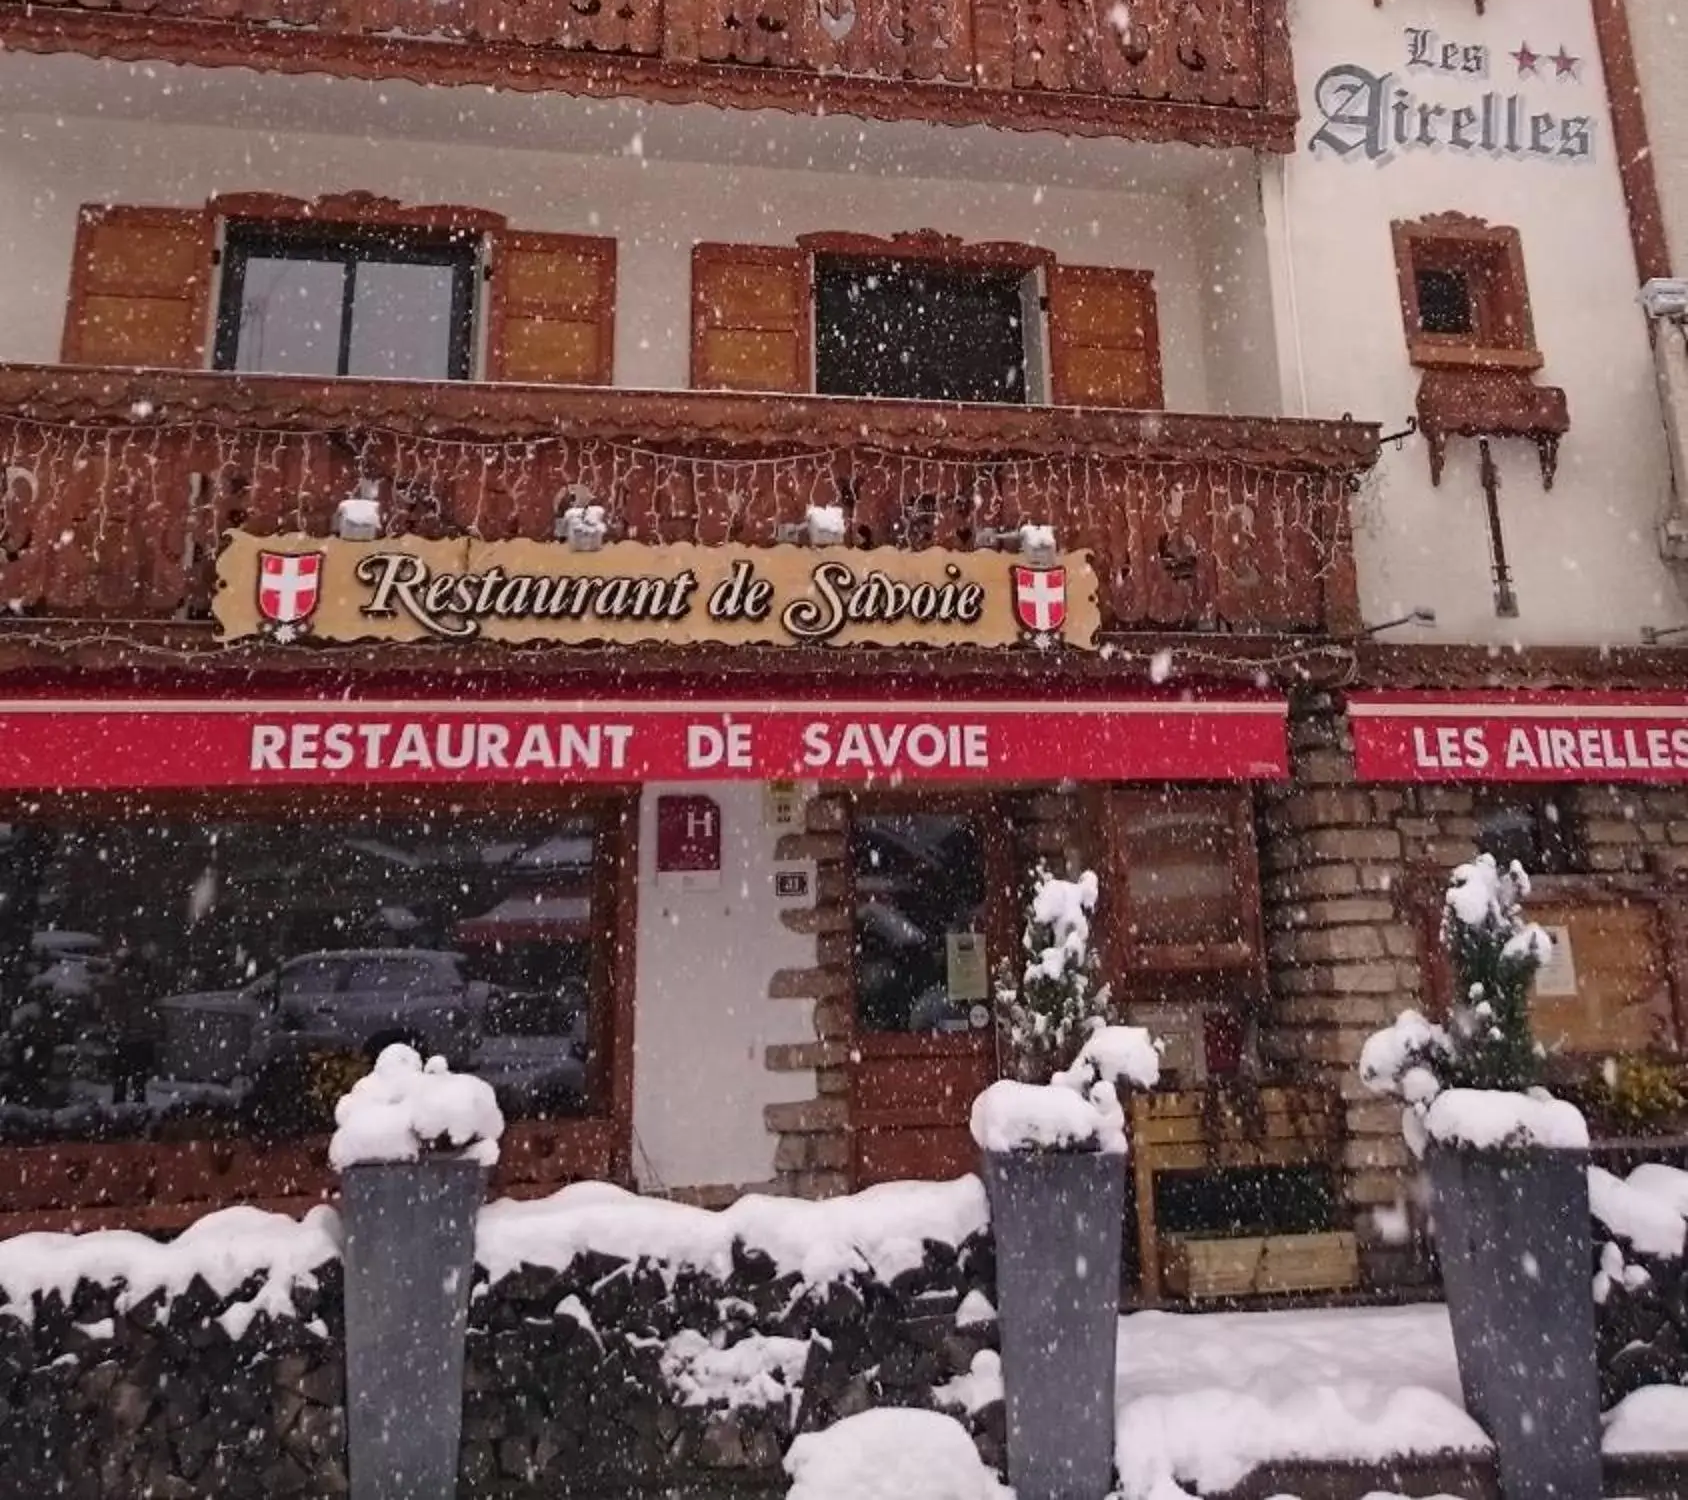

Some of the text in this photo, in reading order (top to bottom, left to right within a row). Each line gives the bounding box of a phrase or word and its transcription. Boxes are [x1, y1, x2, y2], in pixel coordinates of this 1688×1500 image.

[1404, 27, 1485, 75] Les
[1307, 63, 1593, 162] Airelles
[356, 550, 985, 639] Restaurant de Savoie
[249, 722, 989, 771] RESTAURANT DE SAVOIE
[1413, 726, 1688, 770] LES AIRELLES
